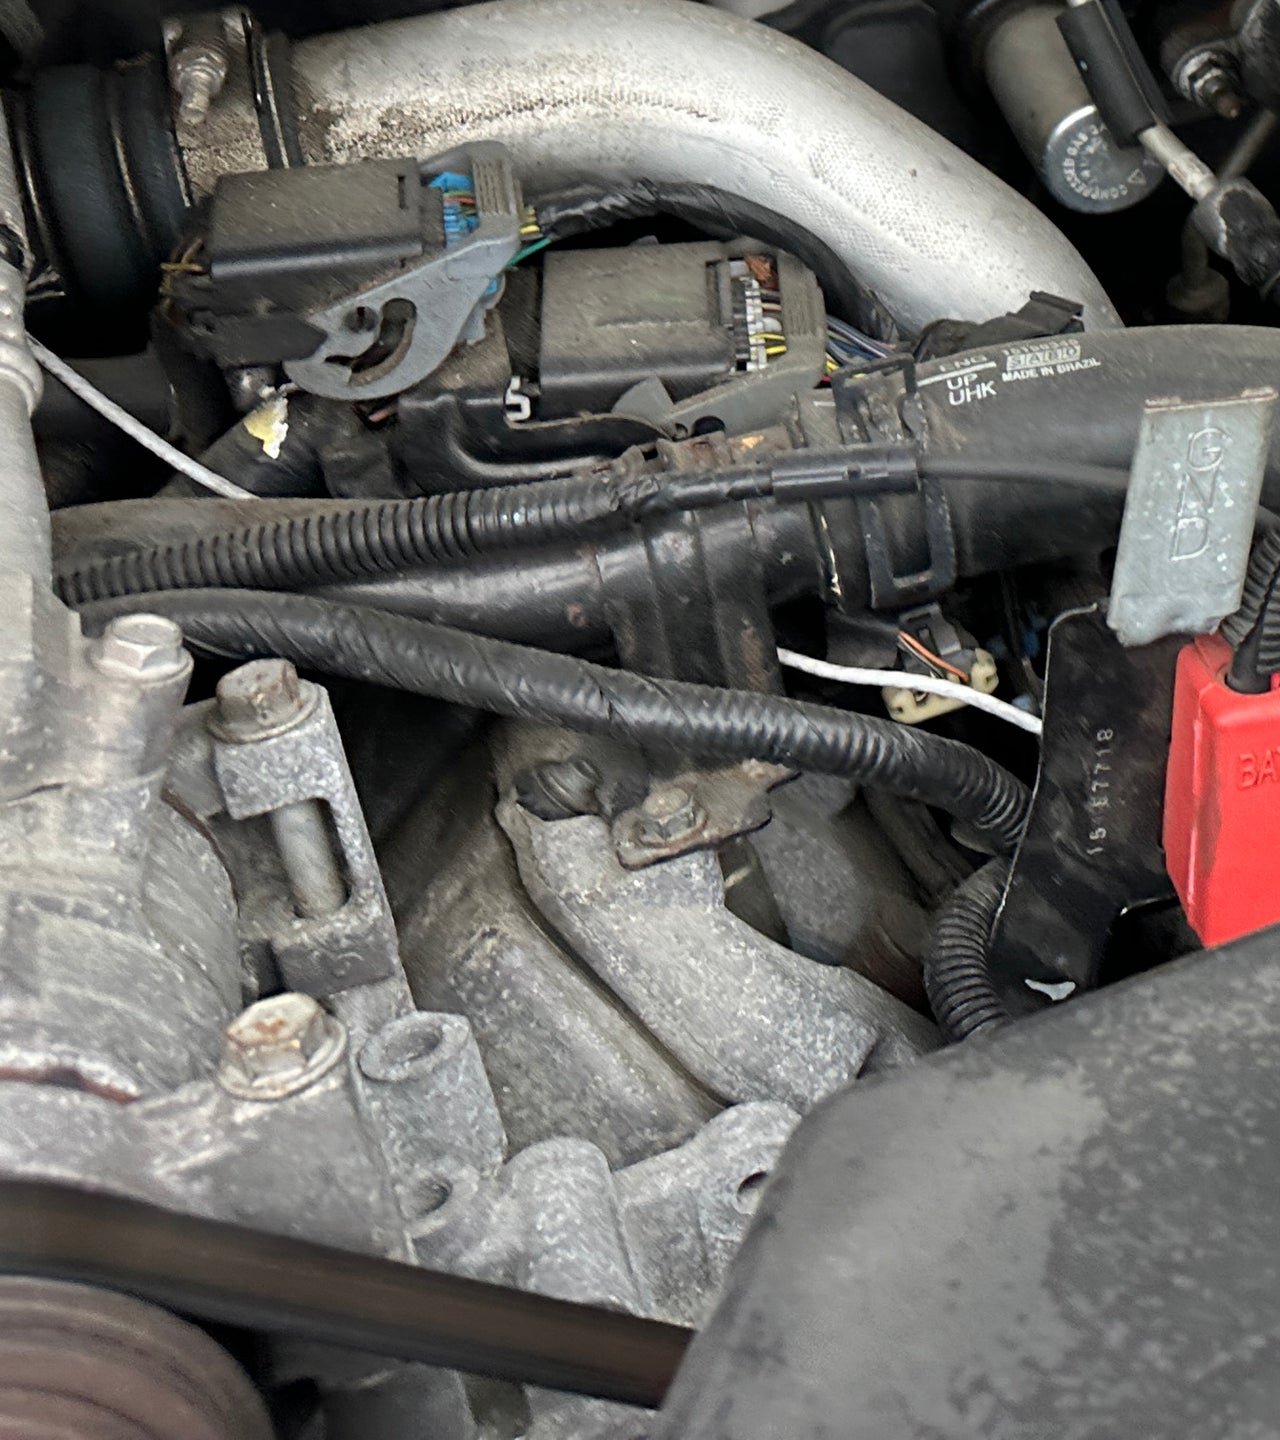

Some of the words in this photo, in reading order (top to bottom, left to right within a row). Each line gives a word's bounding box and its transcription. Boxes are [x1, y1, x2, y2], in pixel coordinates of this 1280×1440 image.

[946, 372, 978, 391] UP
[1001, 368, 1039, 382] MADE
[1040, 366, 1055, 376] IN
[948, 380, 998, 406] UHK
